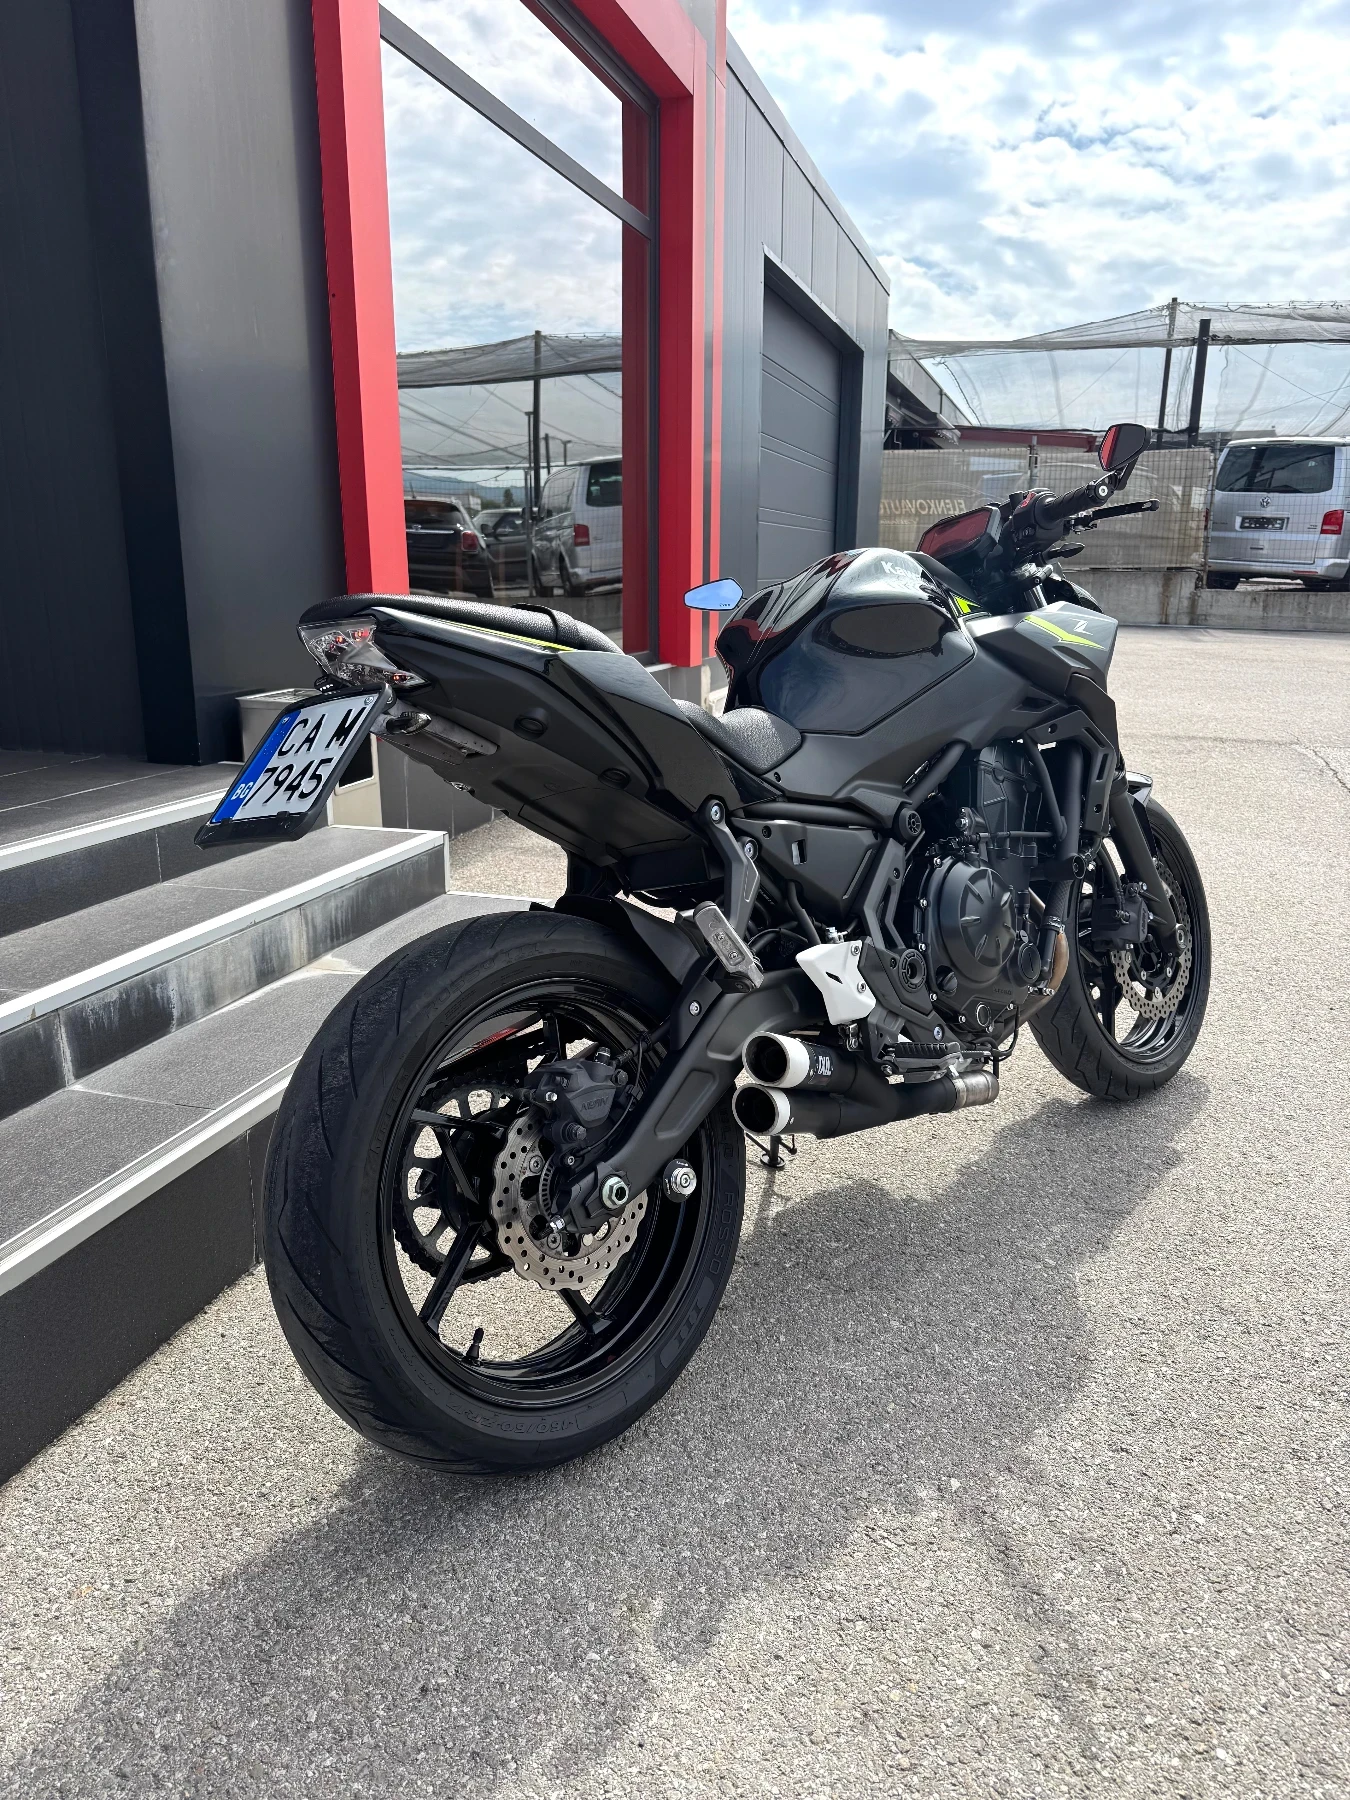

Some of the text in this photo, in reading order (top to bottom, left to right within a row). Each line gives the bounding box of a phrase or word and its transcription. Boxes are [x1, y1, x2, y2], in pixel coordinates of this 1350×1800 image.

[278, 706, 367, 757] CA M
[232, 783, 254, 800] BG
[242, 757, 334, 807] 7945
[709, 1191, 735, 1274] ROSSO
